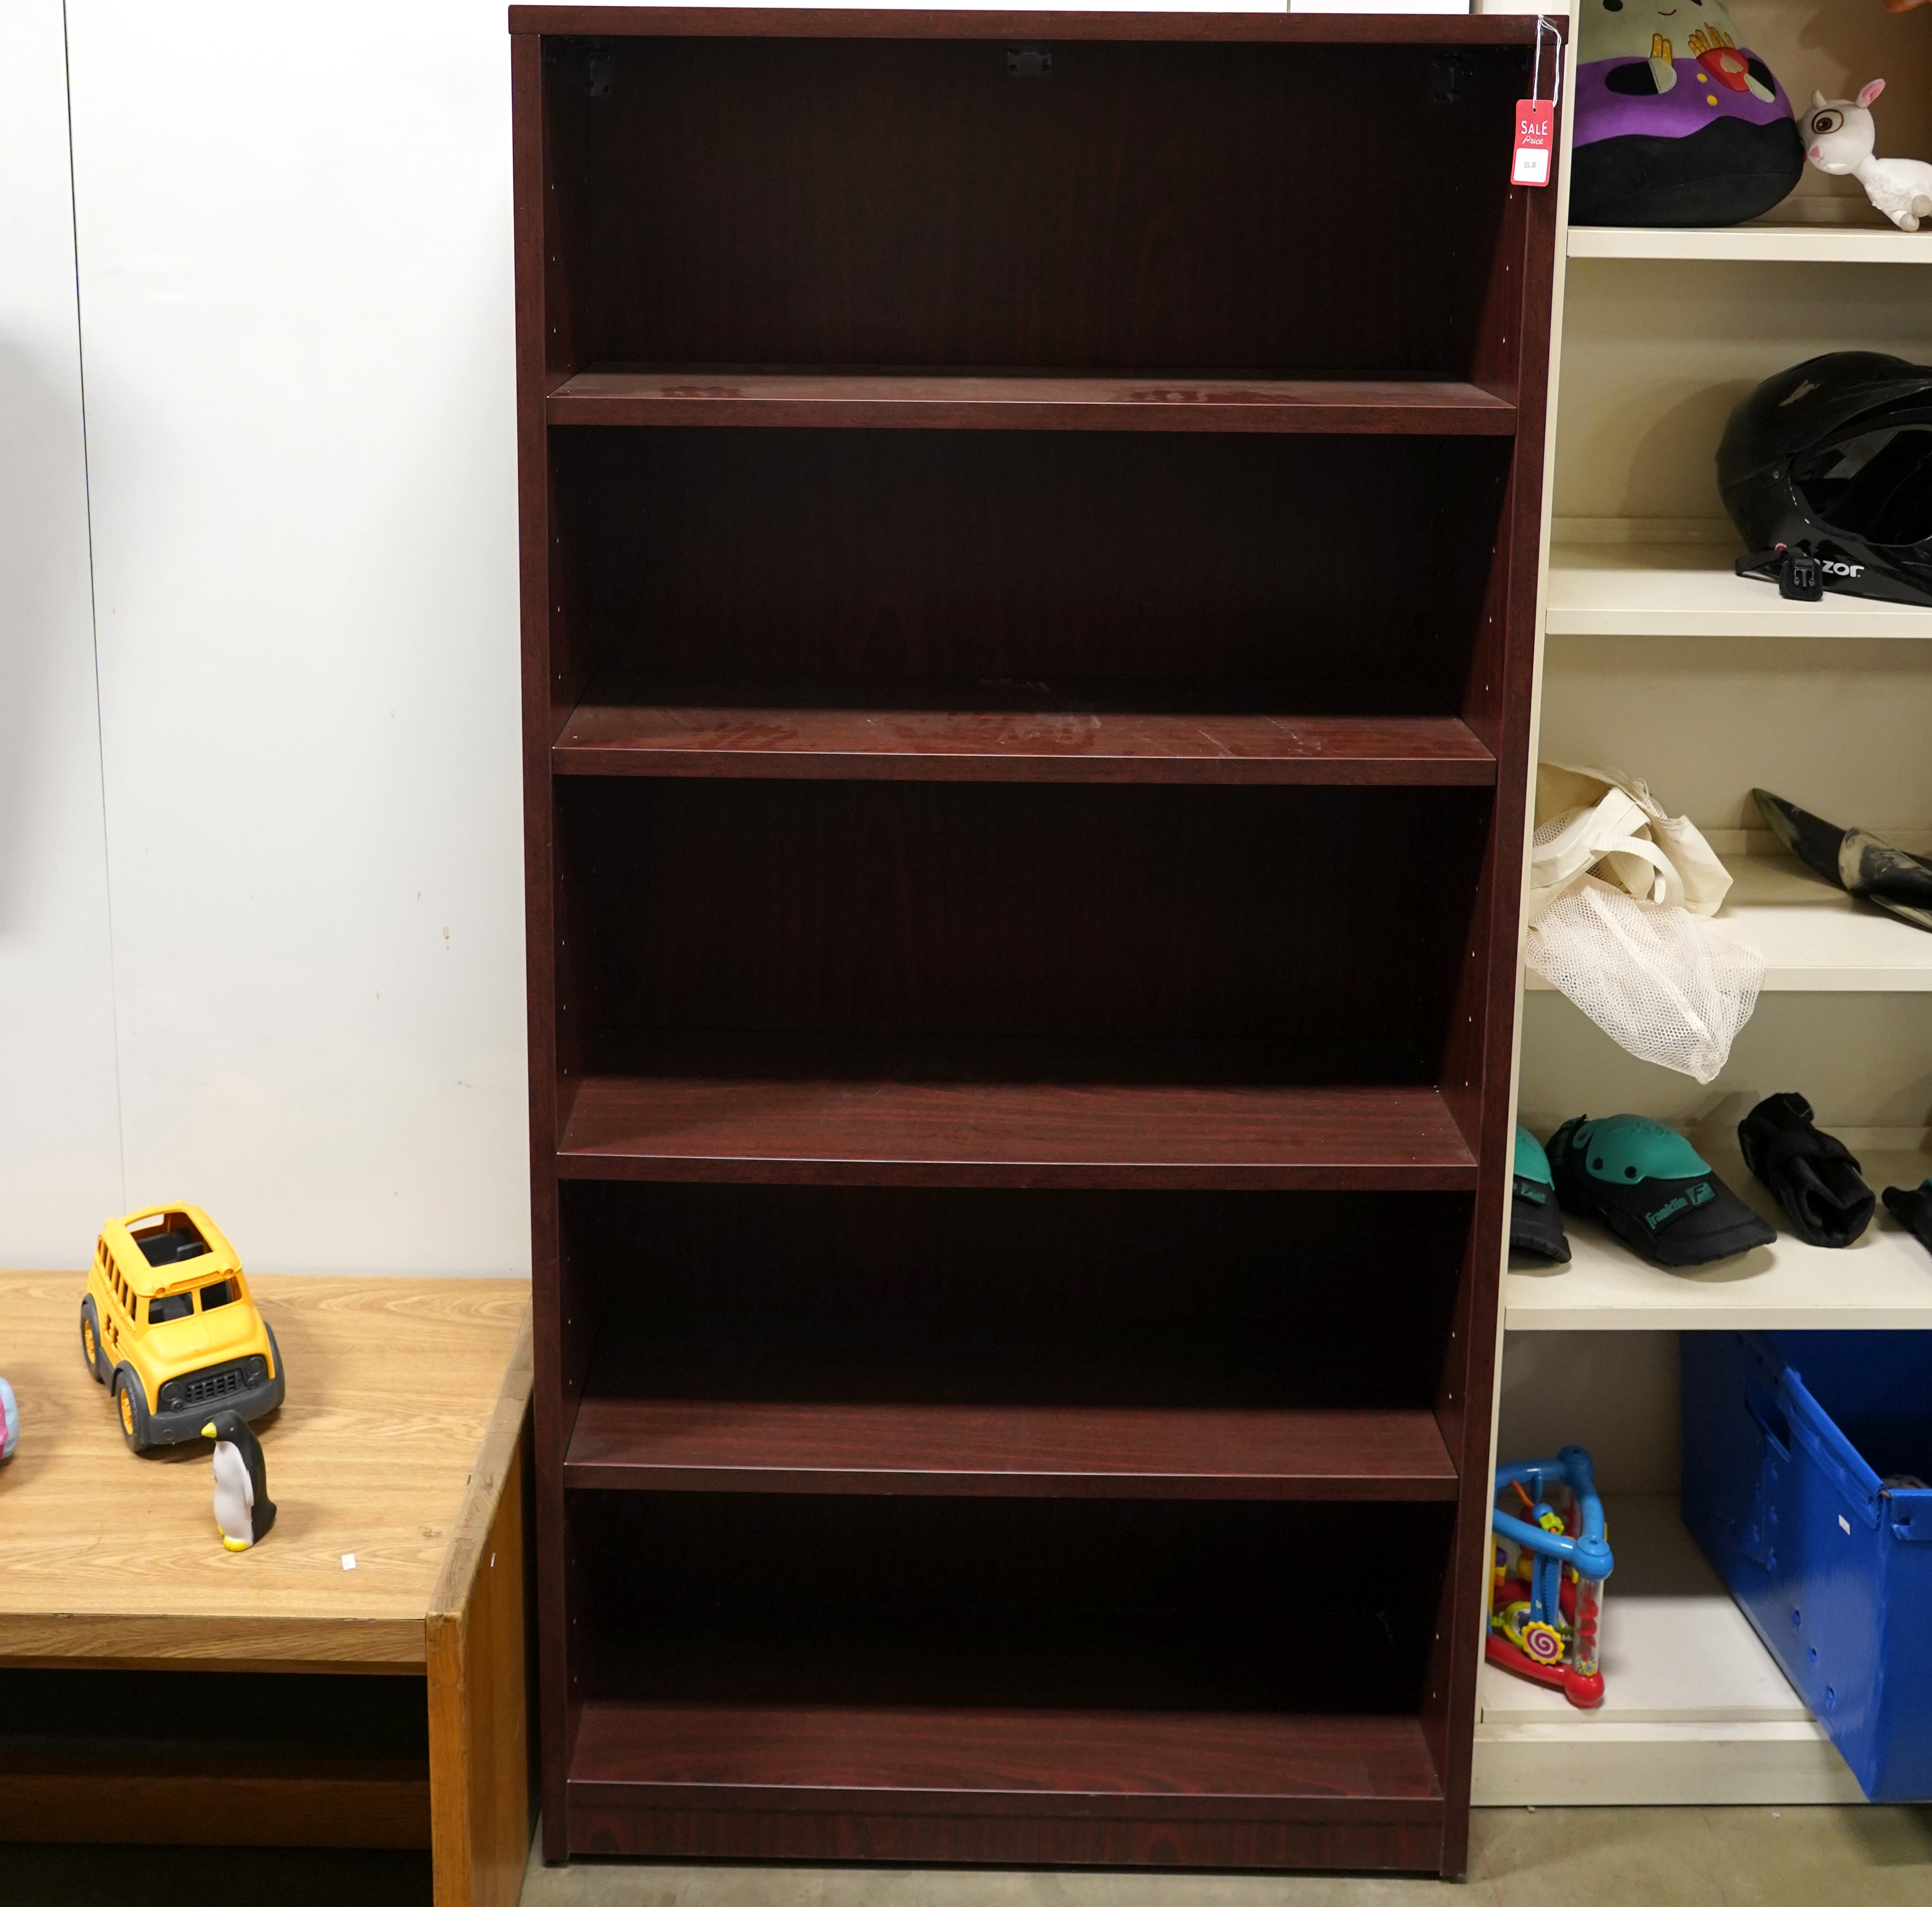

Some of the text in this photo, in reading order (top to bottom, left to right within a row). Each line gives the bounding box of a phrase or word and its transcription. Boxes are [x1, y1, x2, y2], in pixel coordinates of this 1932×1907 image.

[1521, 120, 1547, 135] SALE
[1522, 135, 1543, 145] Price
[1814, 558, 1865, 578] zor
